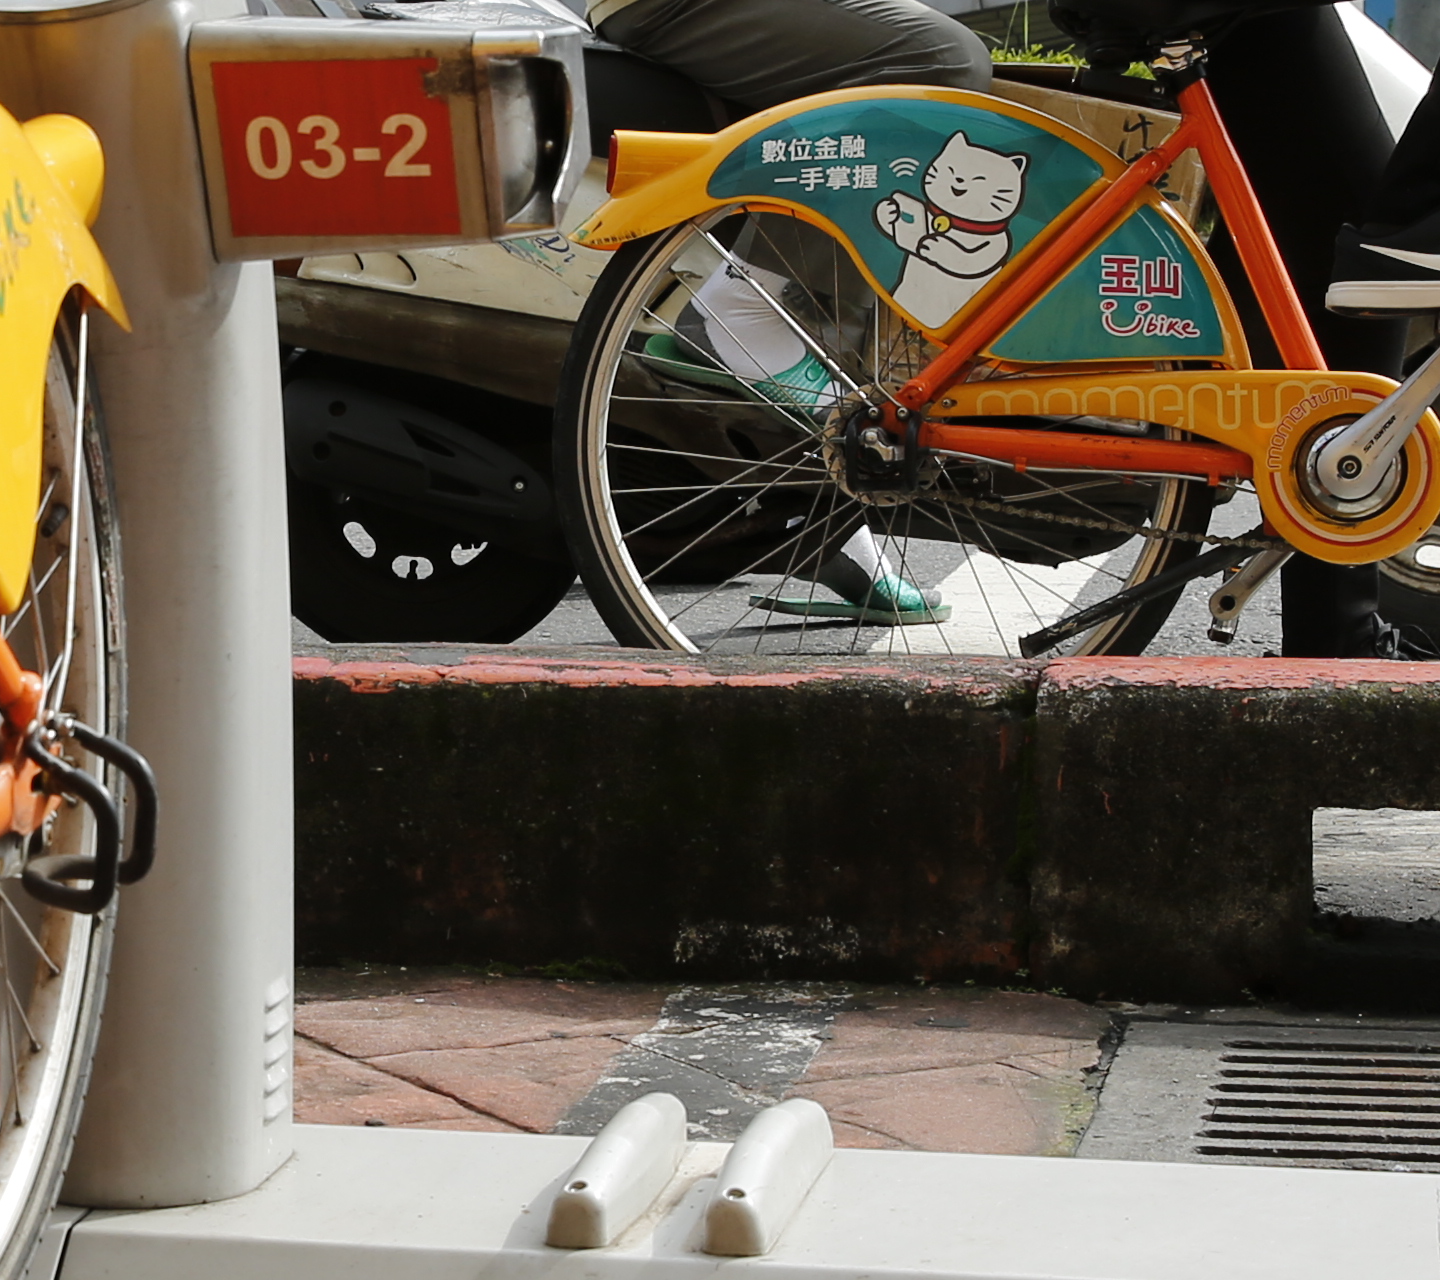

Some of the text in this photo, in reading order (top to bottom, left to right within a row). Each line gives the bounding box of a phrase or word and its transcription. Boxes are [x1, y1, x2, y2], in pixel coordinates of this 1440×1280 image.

[245, 113, 432, 180] 03-2
[761, 134, 866, 164] 數位金融
[773, 164, 878, 192] 一手掌握
[1099, 254, 1182, 299] 玉山
[976, 380, 1336, 431] momentum
[1267, 385, 1350, 470] momentum
